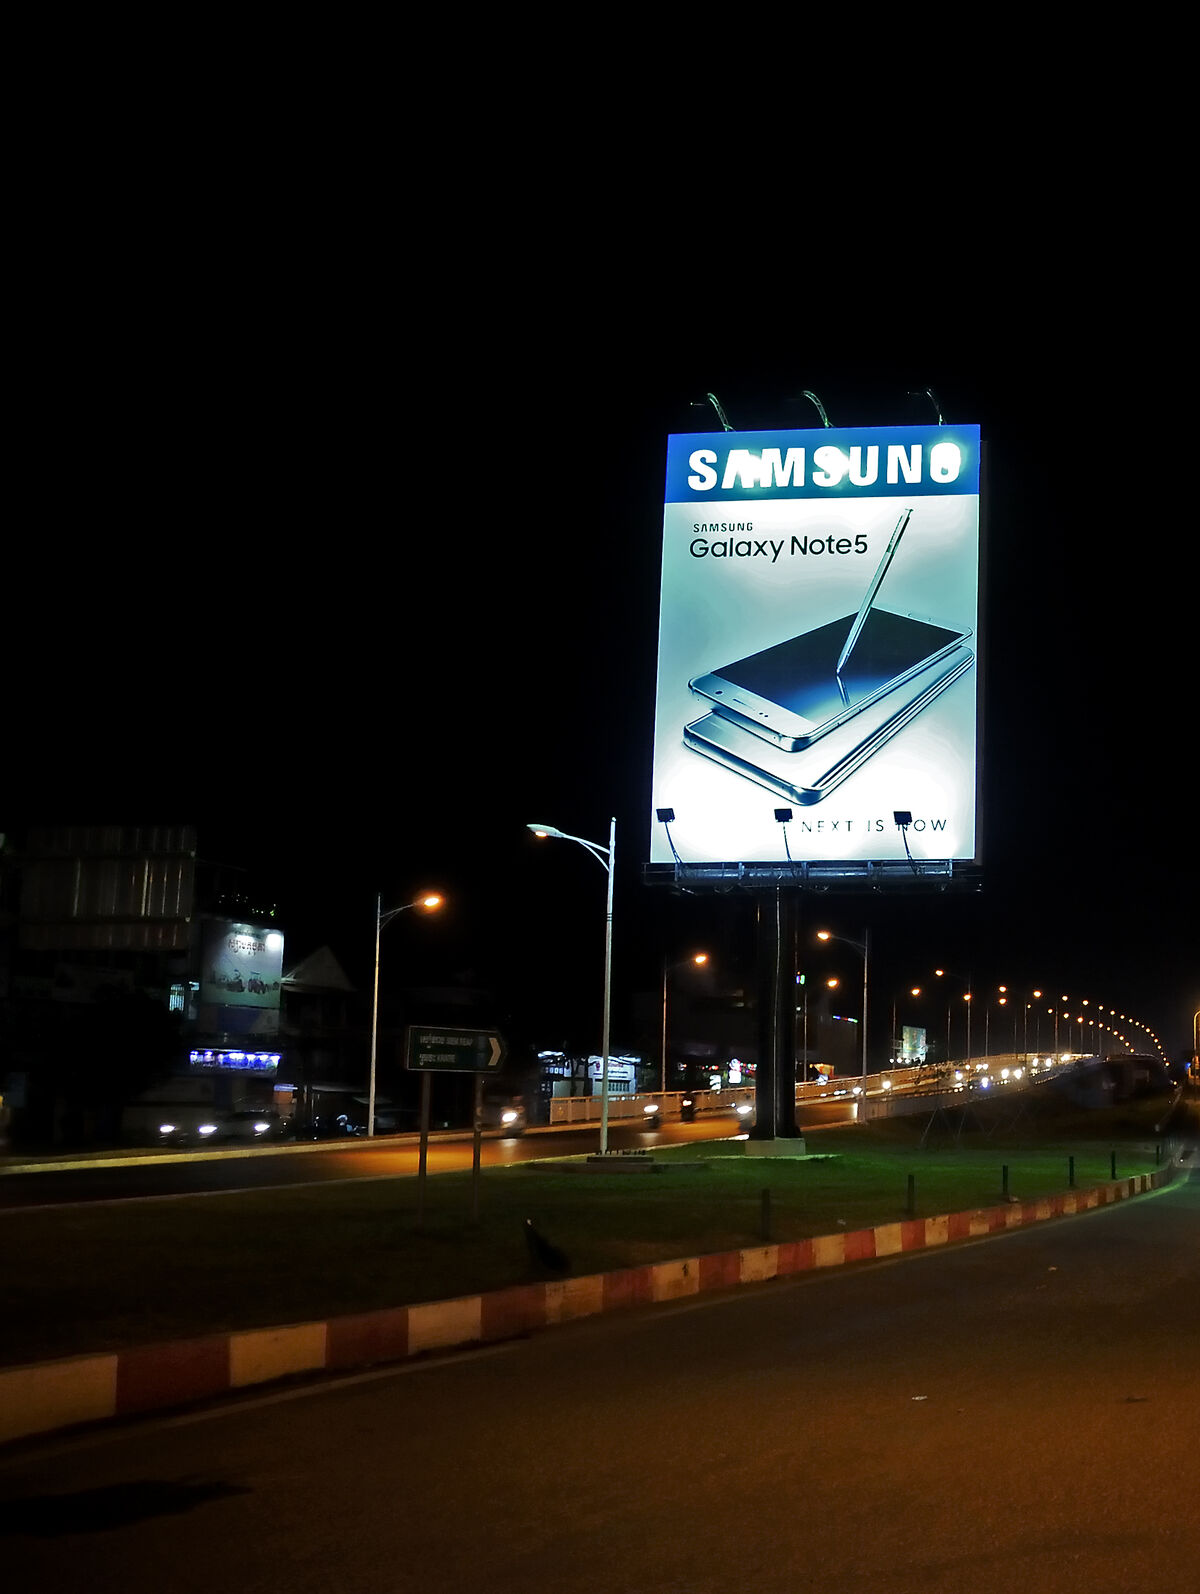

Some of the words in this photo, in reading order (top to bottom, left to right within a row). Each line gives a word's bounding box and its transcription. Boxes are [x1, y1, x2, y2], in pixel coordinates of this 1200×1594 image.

[693, 522, 753, 533] SAMSUNG
[690, 538, 784, 563] Galaxy
[802, 820, 853, 832] NEXT
[868, 819, 884, 832] IS
